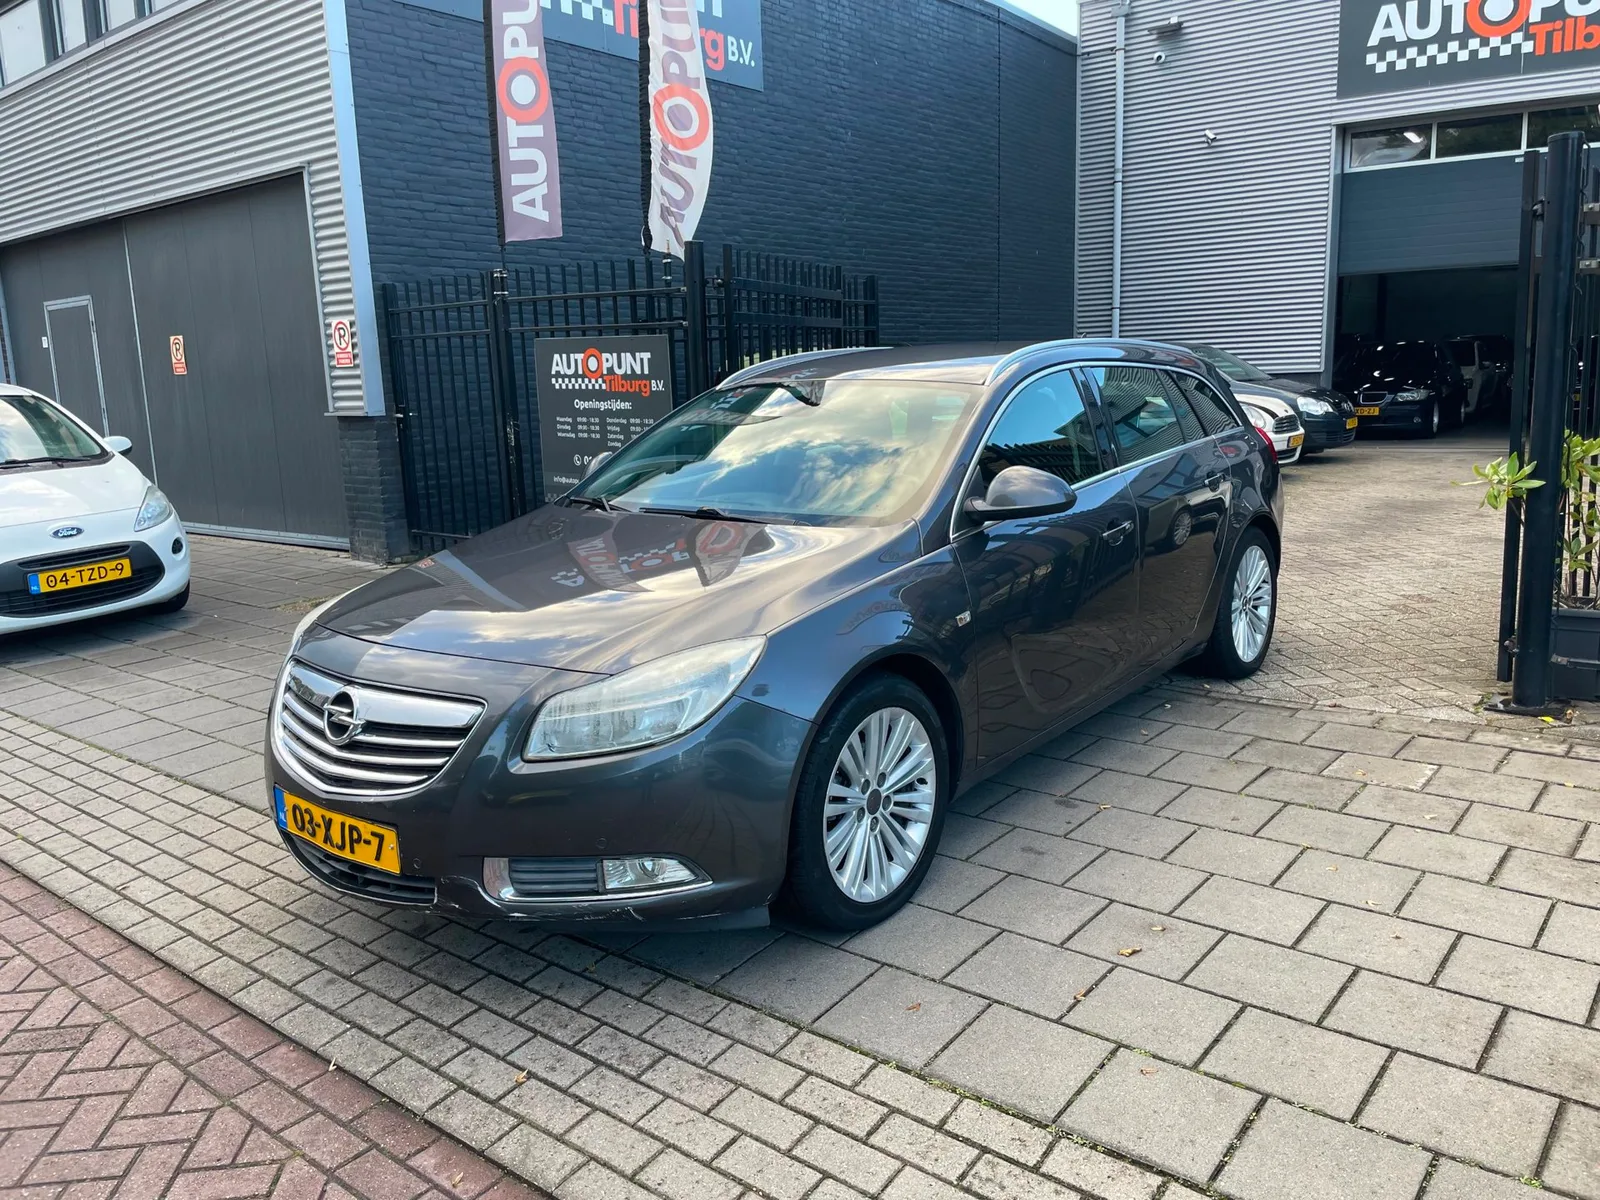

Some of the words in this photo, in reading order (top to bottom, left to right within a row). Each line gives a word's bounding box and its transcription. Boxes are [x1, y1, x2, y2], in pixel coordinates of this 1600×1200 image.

[728, 35, 755, 67] B.V.
[551, 348, 651, 379] AUTOPUNT
[604, 375, 650, 397] Tilburg
[651, 380, 665, 391] B.V.
[574, 399, 632, 411] Openingstijden:
[58, 527, 78, 537] Ford
[46, 562, 124, 588] 04-TZD-9
[292, 803, 385, 861] 03-XJP-7
